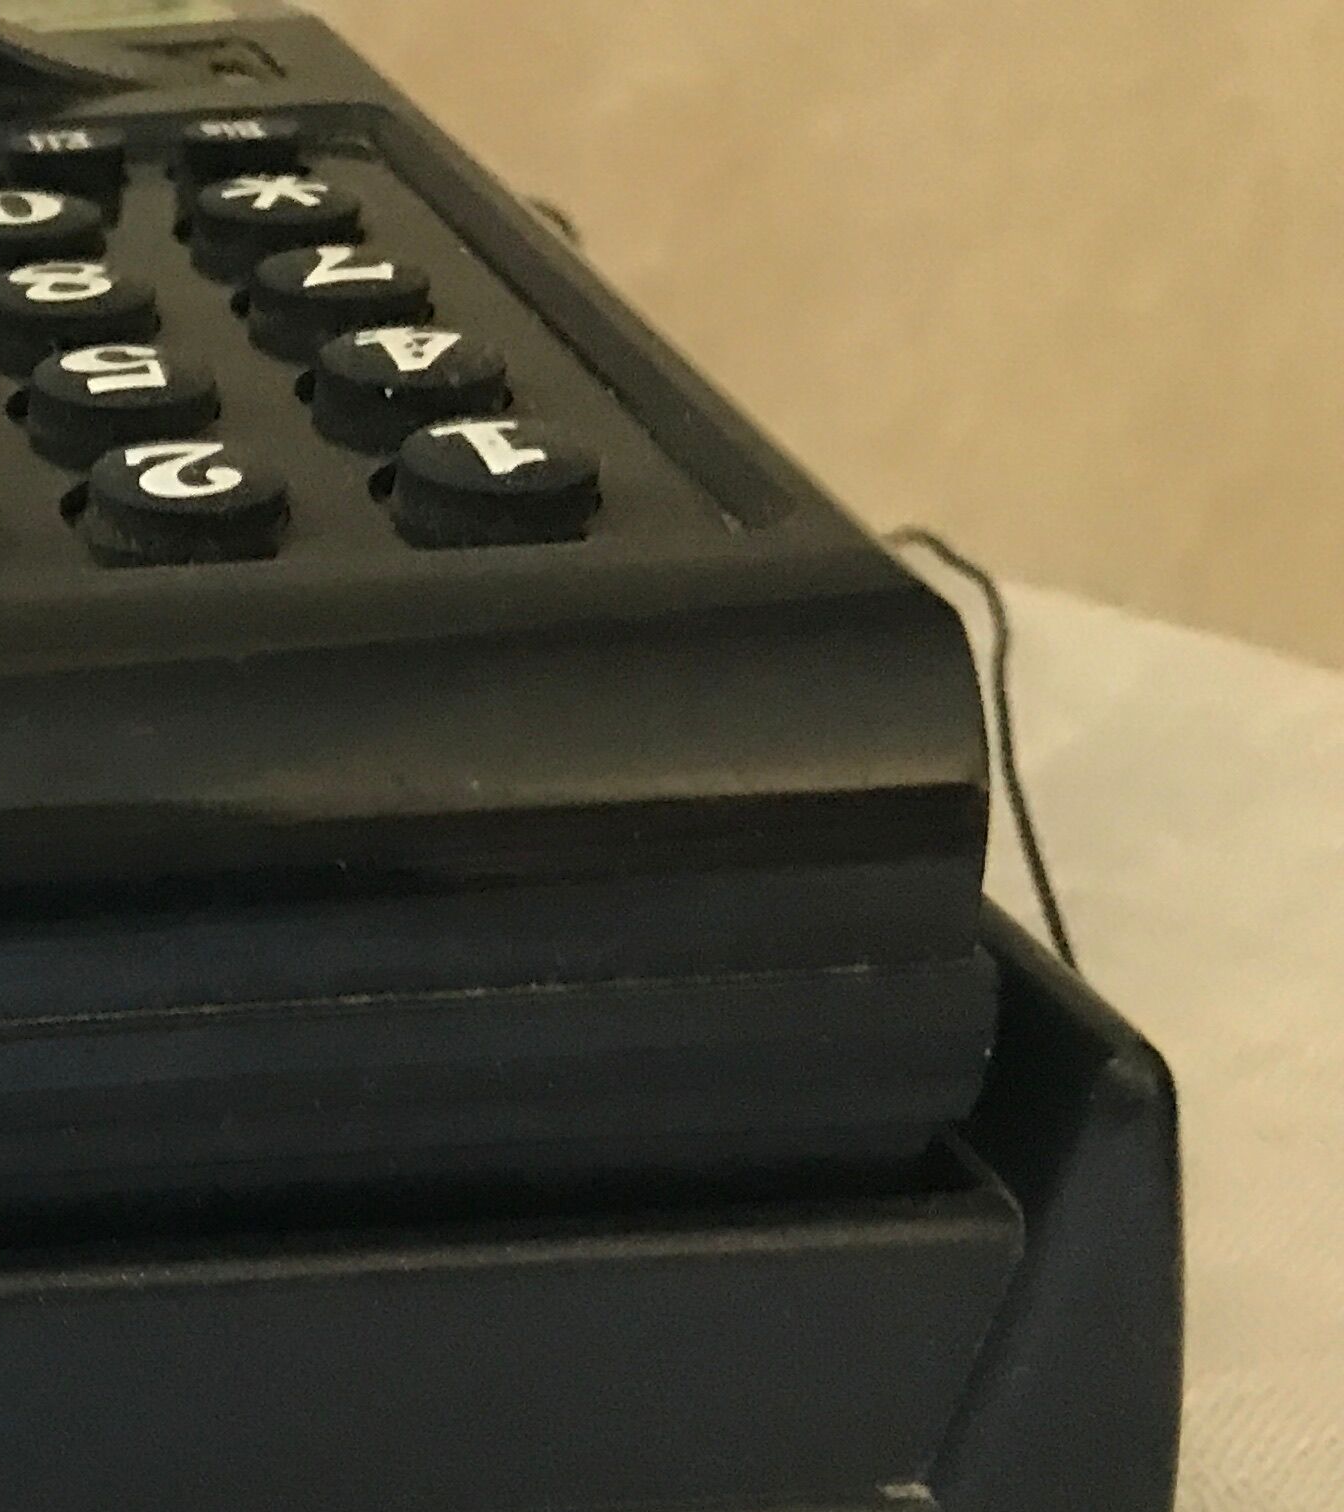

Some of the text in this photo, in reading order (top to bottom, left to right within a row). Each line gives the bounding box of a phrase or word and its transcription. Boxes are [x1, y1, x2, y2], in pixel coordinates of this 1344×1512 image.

[8, 262, 112, 302] 8
[302, 246, 394, 288] 7
[58, 345, 168, 394] 5
[354, 326, 462, 371] 4
[124, 442, 244, 498] 2
[430, 420, 548, 475] 1
